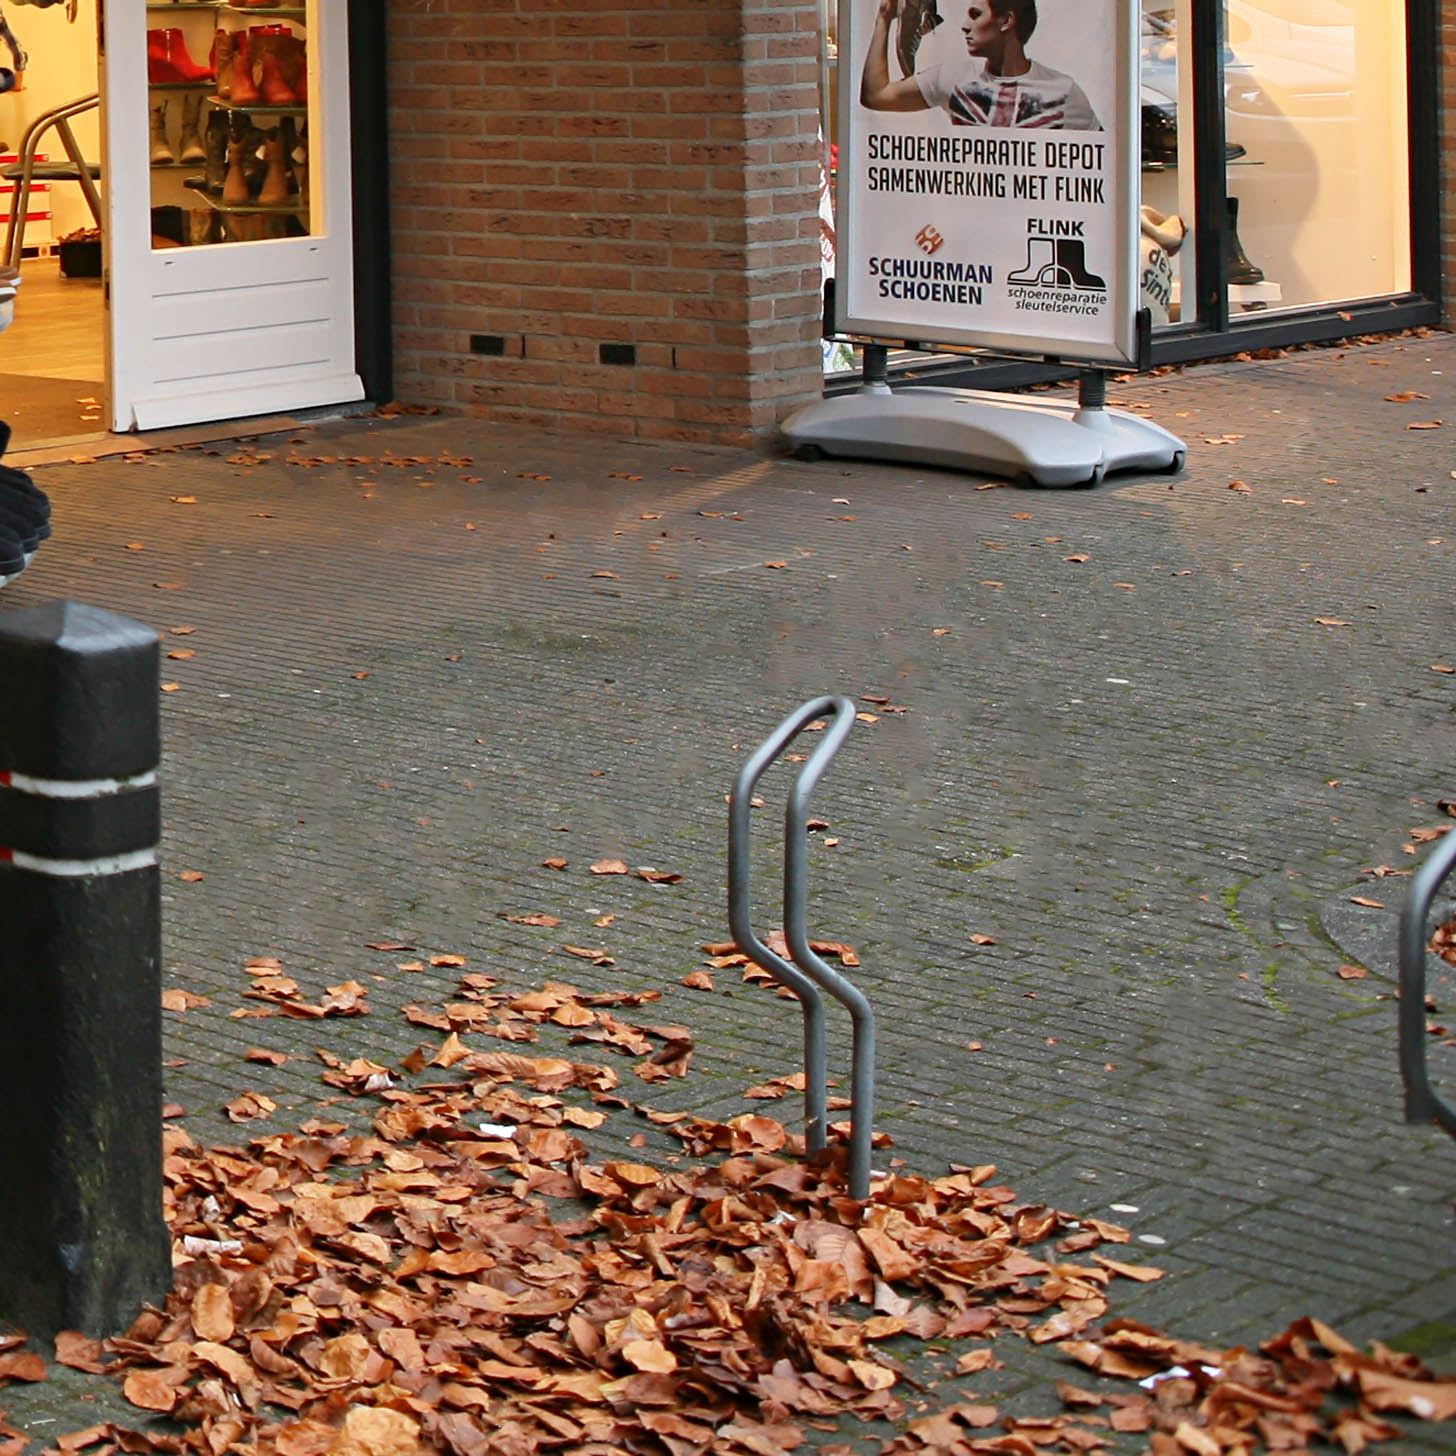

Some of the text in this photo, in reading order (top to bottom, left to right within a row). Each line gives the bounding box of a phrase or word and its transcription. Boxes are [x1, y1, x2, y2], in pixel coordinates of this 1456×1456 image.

[868, 134, 1105, 171] SCHOENREPARATIE DEPOT
[868, 166, 1105, 204] SAMENWERKING MET FLINK
[1027, 218, 1085, 237] FLINK
[868, 256, 993, 284] SCHUURMAN
[879, 279, 982, 305] SCHOENEN
[1007, 287, 1108, 305] schoenreparatie
[1015, 299, 1099, 316] sleutelservice
